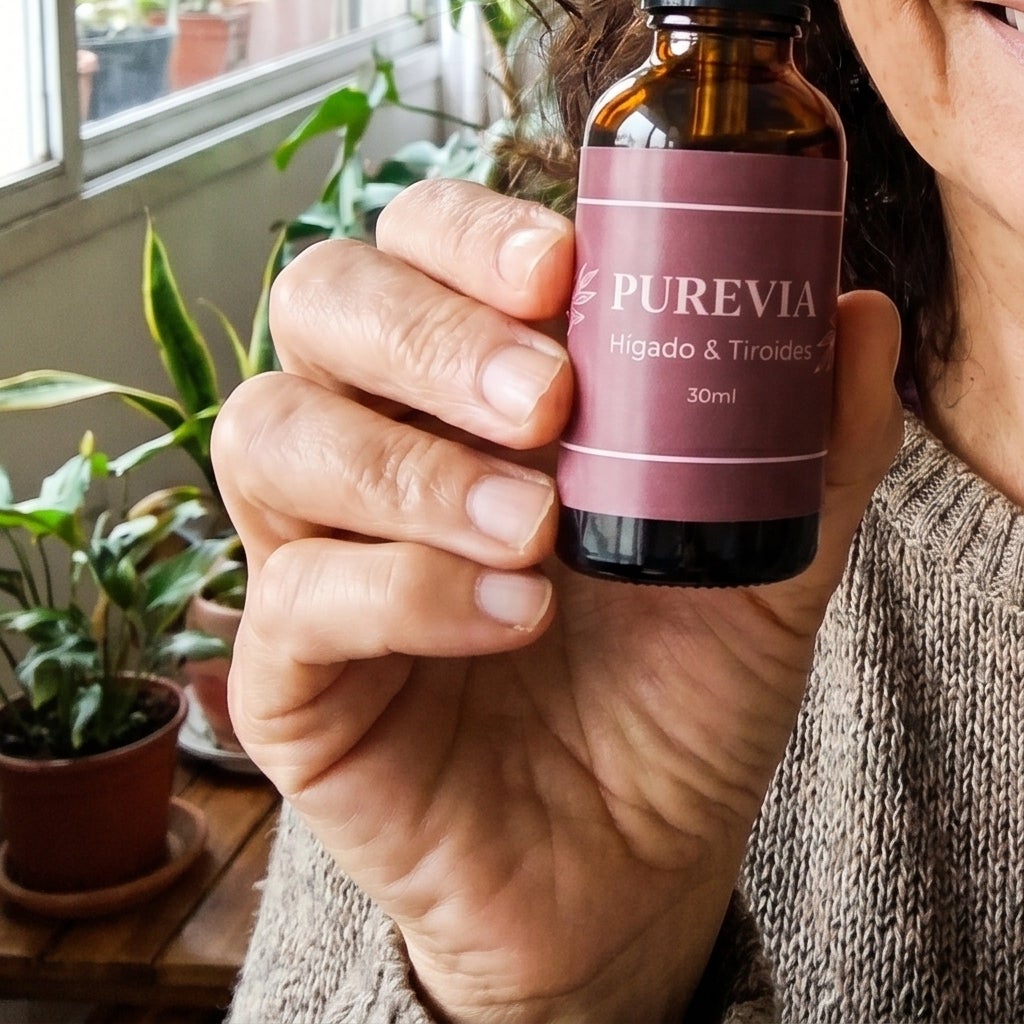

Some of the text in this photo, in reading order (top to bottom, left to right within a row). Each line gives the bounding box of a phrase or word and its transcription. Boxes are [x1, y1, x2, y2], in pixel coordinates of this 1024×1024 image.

[610, 272, 817, 318] PUREVIA
[610, 333, 812, 362] Hígado & Tiroides
[686, 387, 737, 405] 30ml
